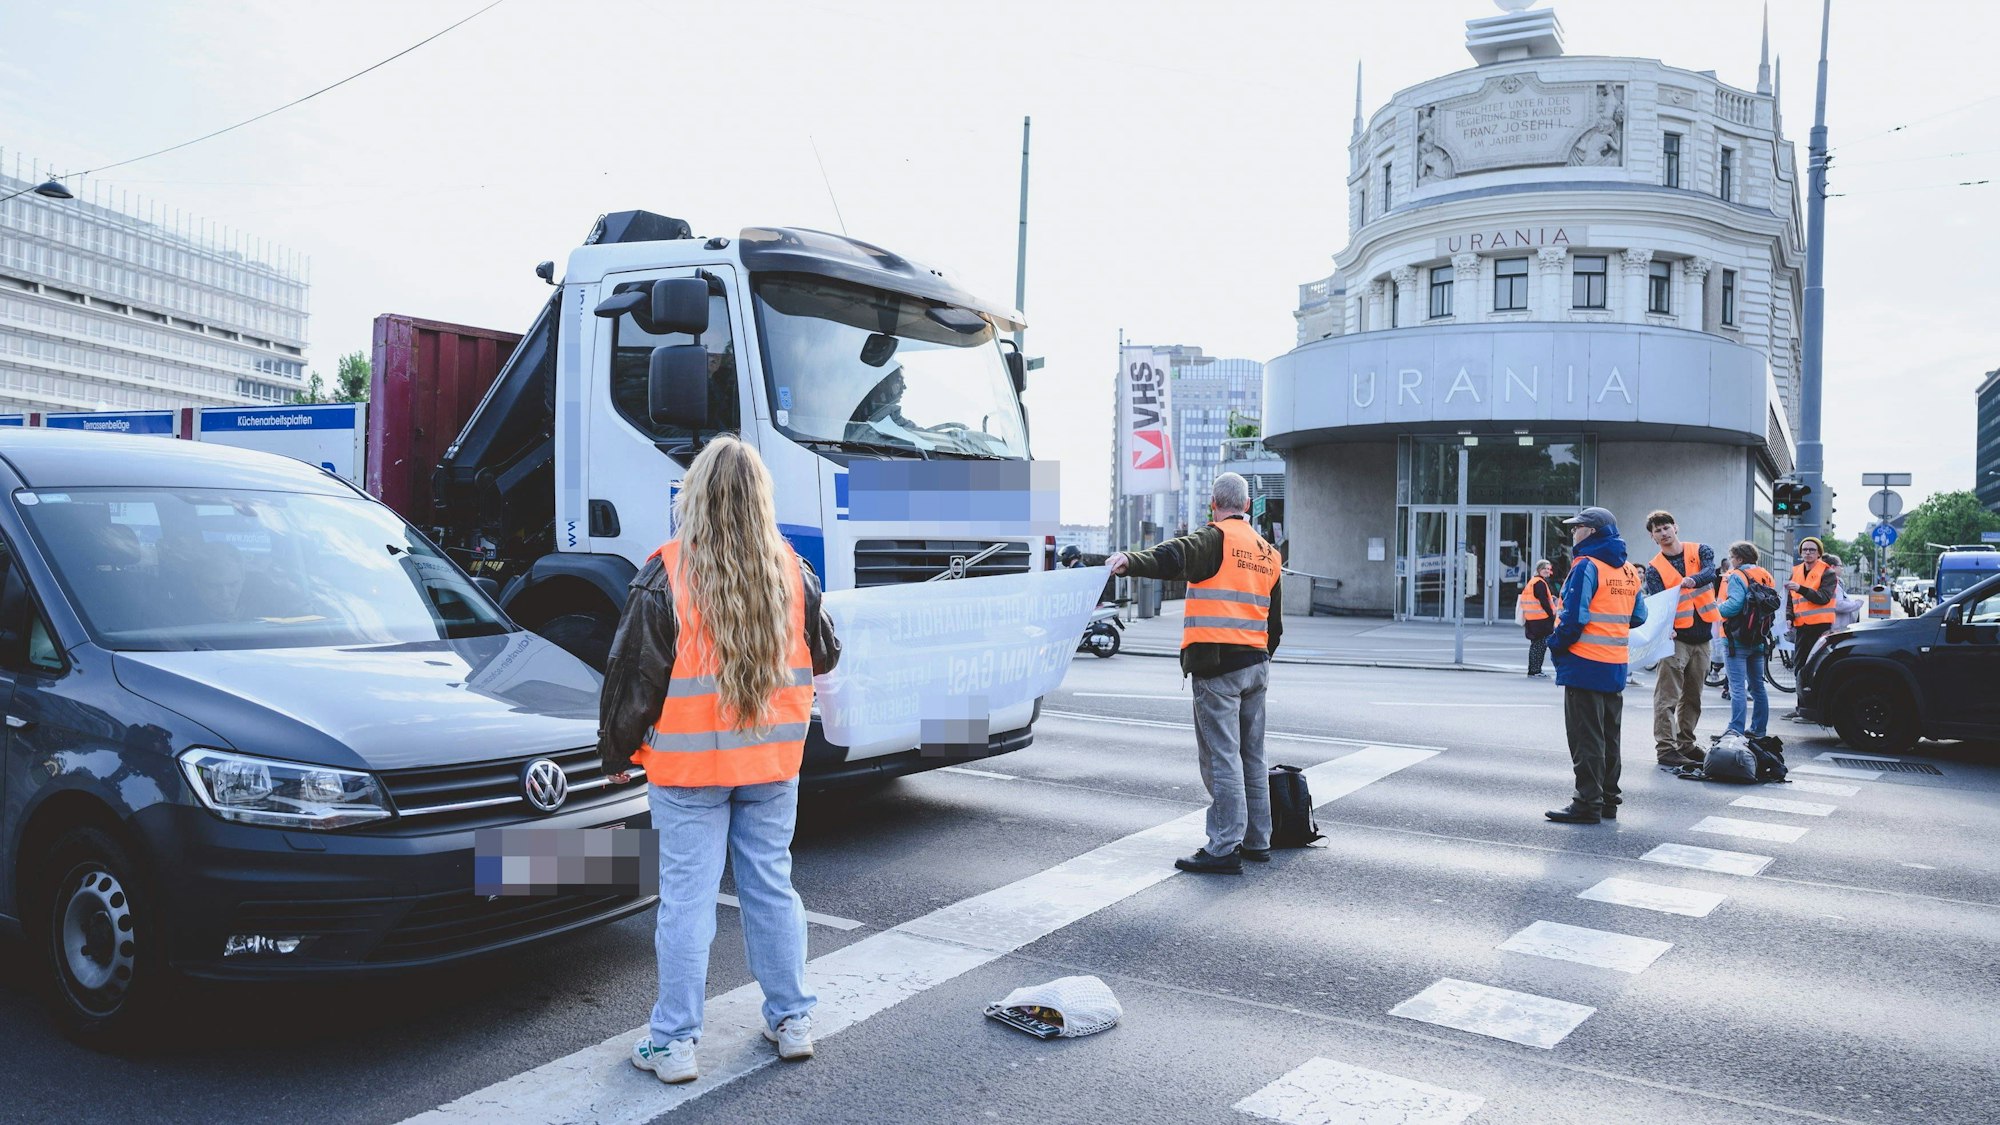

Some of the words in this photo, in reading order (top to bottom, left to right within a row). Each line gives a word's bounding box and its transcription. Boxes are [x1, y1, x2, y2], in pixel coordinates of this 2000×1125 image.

[1456, 101, 1504, 119] ERRICHTET
[1508, 97, 1544, 109] UNTER
[1548, 95, 1570, 106] DER
[1456, 113, 1506, 129] REGIERUNG
[1510, 109, 1529, 119] DES
[1532, 106, 1572, 117] KAISERS
[1463, 124, 1498, 140] FRANZ
[1502, 119, 1553, 133] JOSEPH
[1474, 140, 1484, 148] IM
[1490, 134, 1521, 147] JAHRE
[1526, 133, 1548, 142] 1910
[1448, 228, 1570, 253] URANIA
[1130, 361, 1160, 430] VHS
[1353, 365, 1632, 408] URANIA
[237, 414, 313, 428] Küchenarbeitsplatten
[1231, 548, 1253, 560] LETZTE
